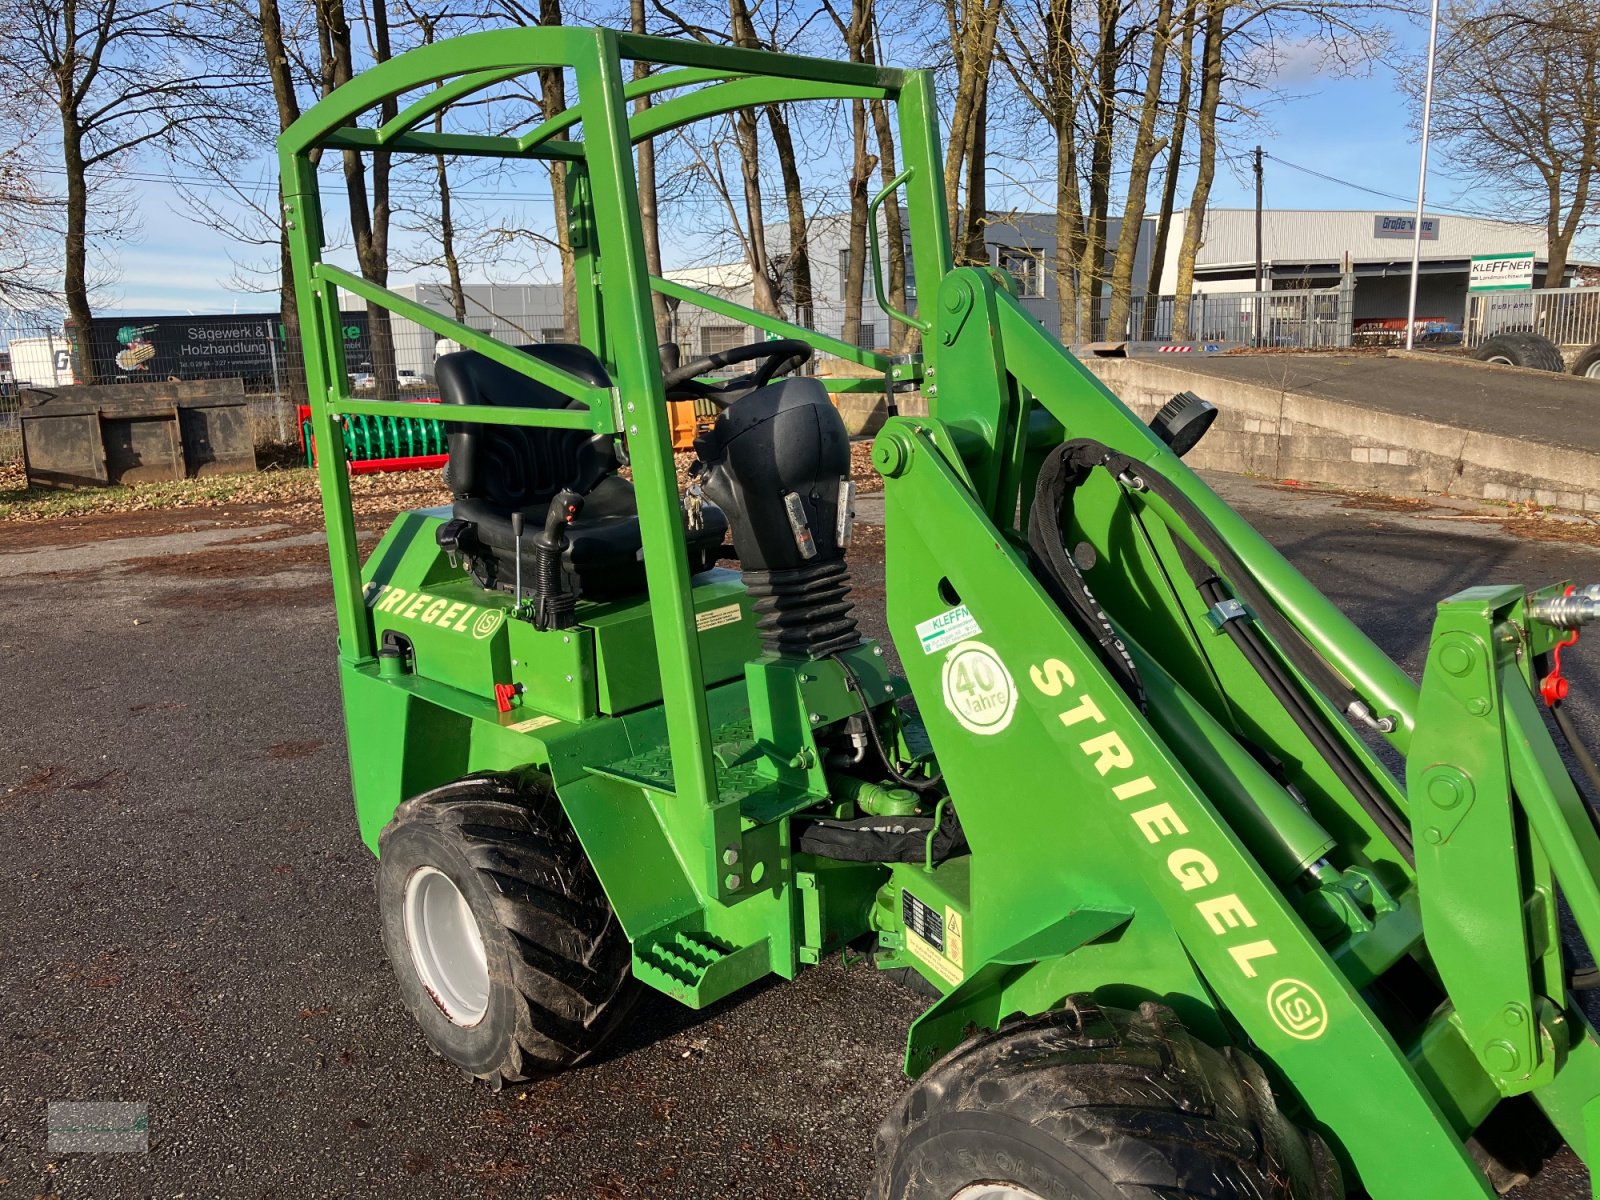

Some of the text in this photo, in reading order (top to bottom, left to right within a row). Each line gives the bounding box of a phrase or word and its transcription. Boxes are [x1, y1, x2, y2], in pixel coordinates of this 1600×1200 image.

[1472, 260, 1532, 273] KLEFFNER
[187, 326, 264, 341] Sägewerk &
[181, 342, 267, 355] Holzhandlung
[955, 655, 995, 697] 40
[964, 691, 1007, 716] Jahre
[1029, 658, 1278, 979] STRIEGEL
